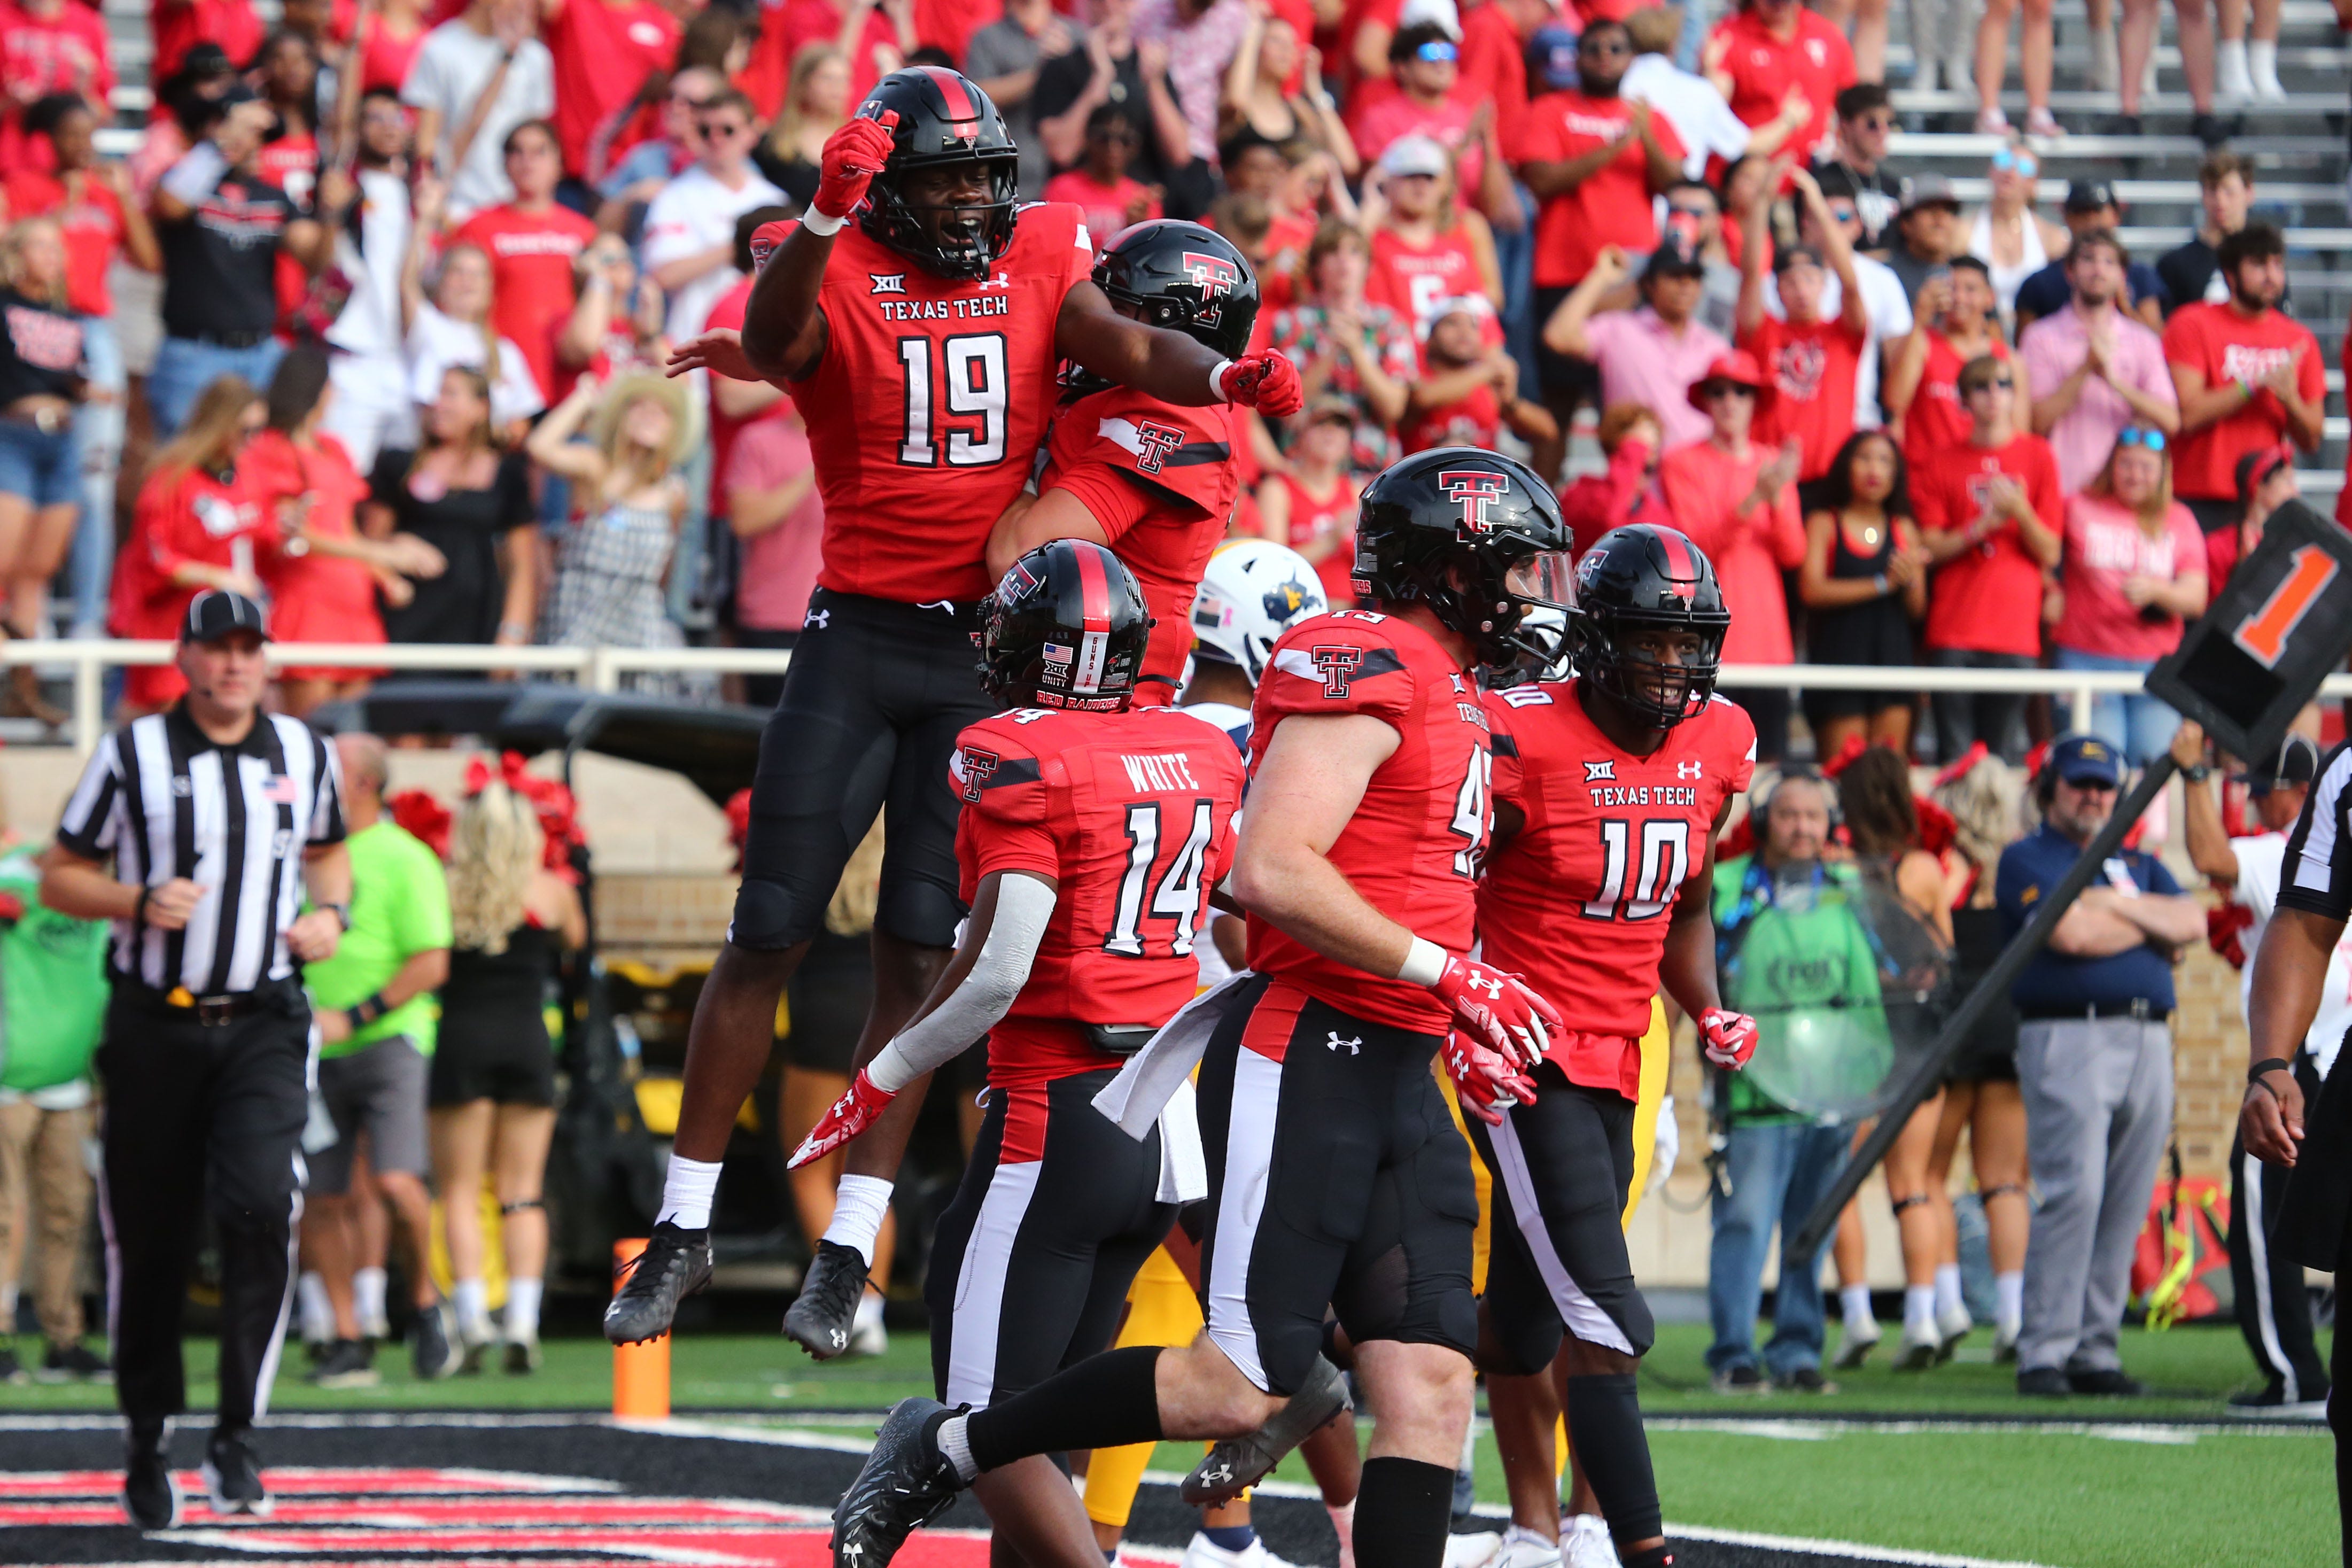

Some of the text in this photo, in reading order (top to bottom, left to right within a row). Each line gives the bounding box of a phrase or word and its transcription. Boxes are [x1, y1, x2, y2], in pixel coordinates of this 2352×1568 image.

[880, 295, 1008, 321] TEXAS TECH
[897, 331, 1008, 468] 19
[2232, 543, 2340, 671] 1
[1042, 674, 1067, 688] UNITY
[1084, 637, 1098, 687] GUNS UP
[1036, 690, 1064, 707] RED
[1066, 697, 1121, 710] RAIDERS
[1121, 752, 1200, 793] WHITE
[1590, 786, 1696, 806] TEXAS TECH
[1103, 798, 1213, 958] 14
[1580, 819, 1690, 921] 10
